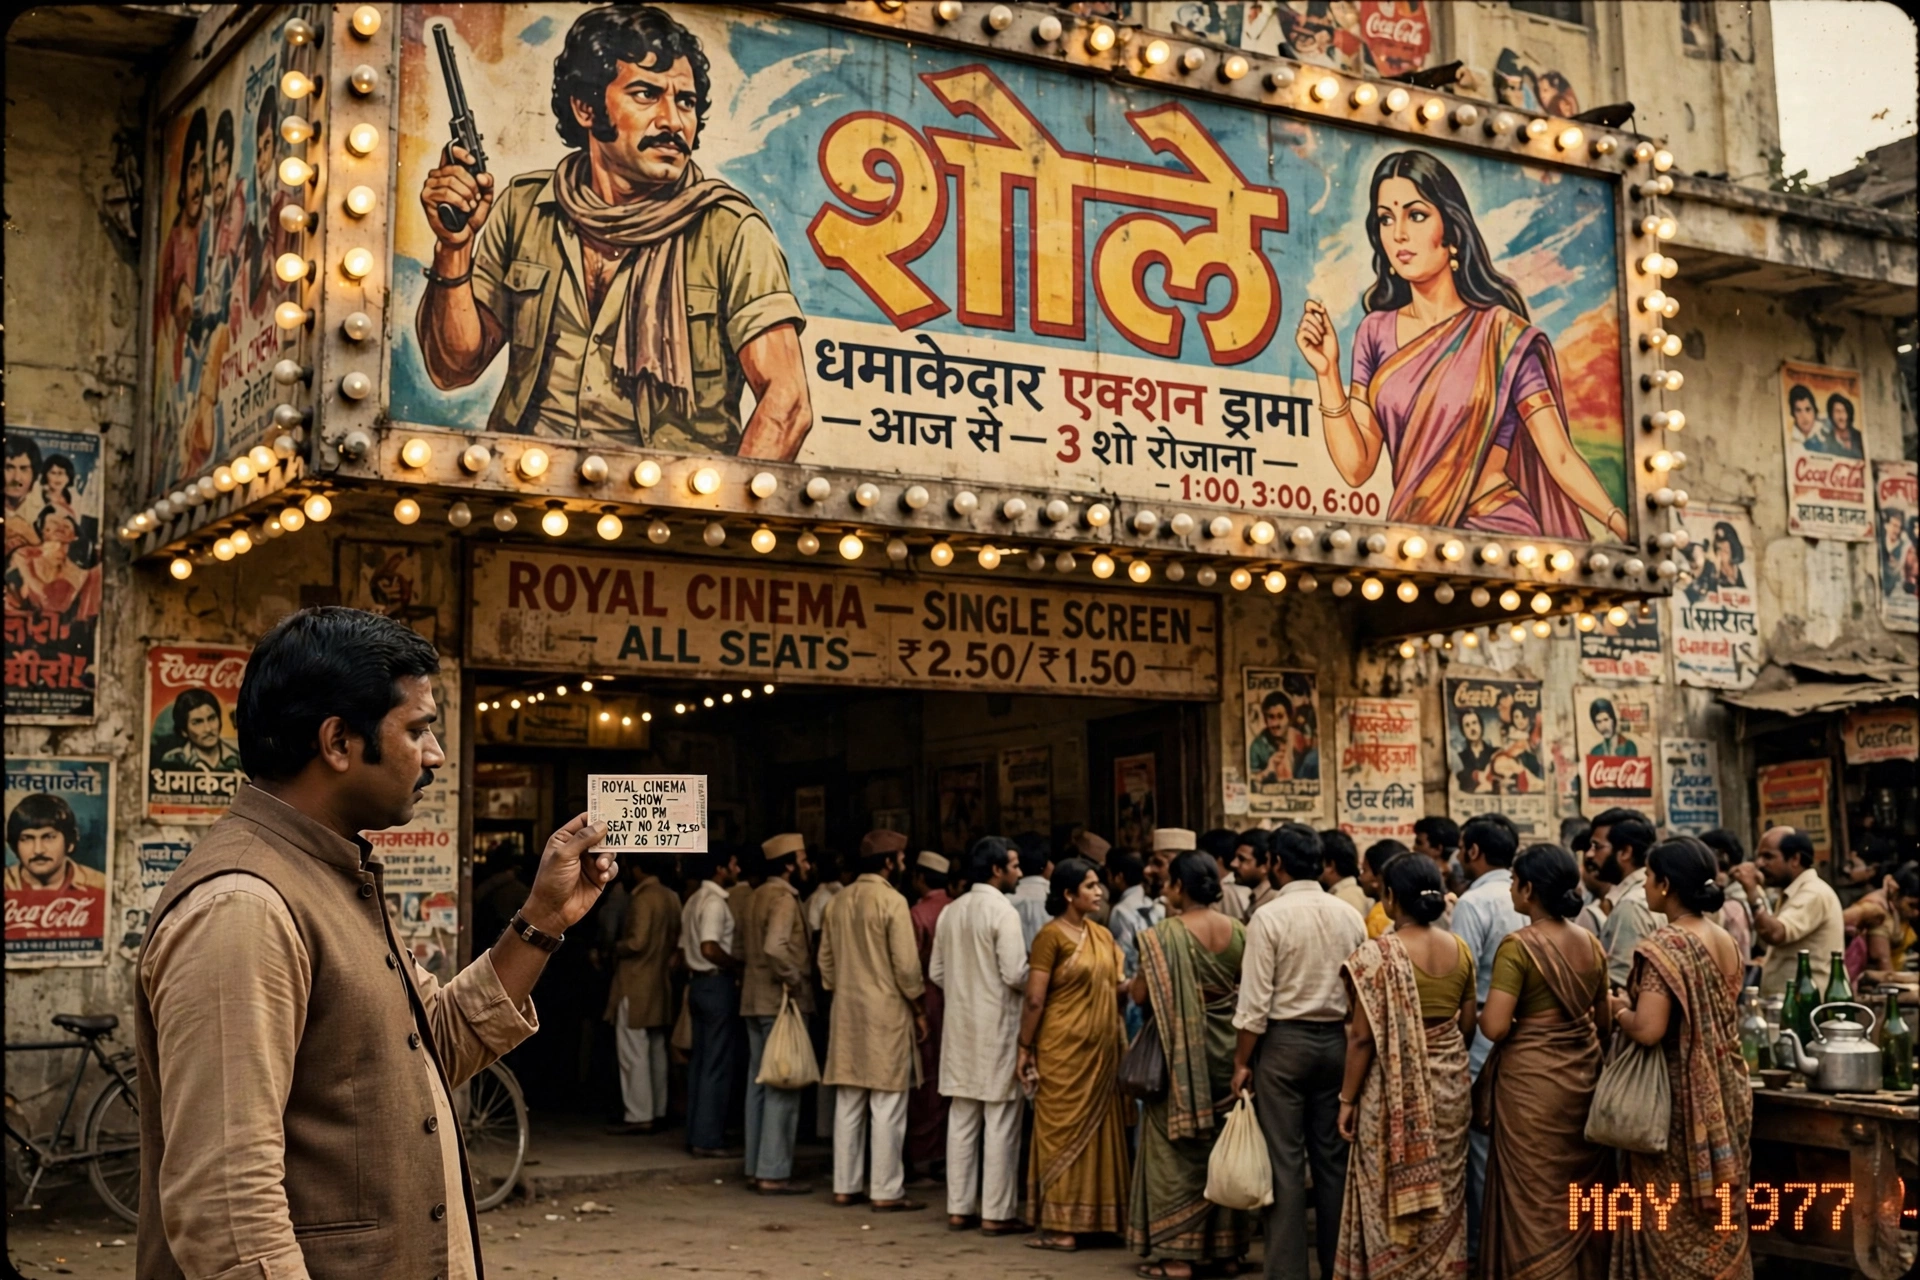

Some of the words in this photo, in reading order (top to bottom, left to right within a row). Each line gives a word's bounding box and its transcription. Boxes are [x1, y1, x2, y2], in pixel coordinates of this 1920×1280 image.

[806, 63, 1288, 365] शोले
[815, 334, 1046, 412] धमाकेदार
[1059, 368, 1208, 426] एक्शन
[1220, 386, 1313, 440] ड्रामा
[868, 407, 956, 449] आज
[966, 406, 1004, 453] से
[1055, 426, 1082, 464] 3
[1092, 422, 1137, 467] शो
[1146, 427, 1256, 477] रोजाना
[1324, 487, 1382, 518] 6:00
[508, 560, 668, 618] ROYAL
[686, 573, 867, 630] CINEMA
[922, 590, 1050, 637] SINGLE
[1062, 600, 1191, 645] SCREEN
[617, 625, 701, 664] ALL
[718, 630, 850, 671] SEATS
[602, 780, 638, 793] ROYAL
[643, 780, 687, 793] CINEMA
[632, 794, 663, 806] SHOW
[607, 820, 633, 832] SEAT
[638, 820, 652, 832] NO
[657, 820, 670, 832] 24
[621, 807, 647, 818] 3:00
[652, 807, 667, 819] PM
[605, 834, 628, 846] MAY
[634, 834, 648, 846] 26
[654, 834, 680, 846] 1977
